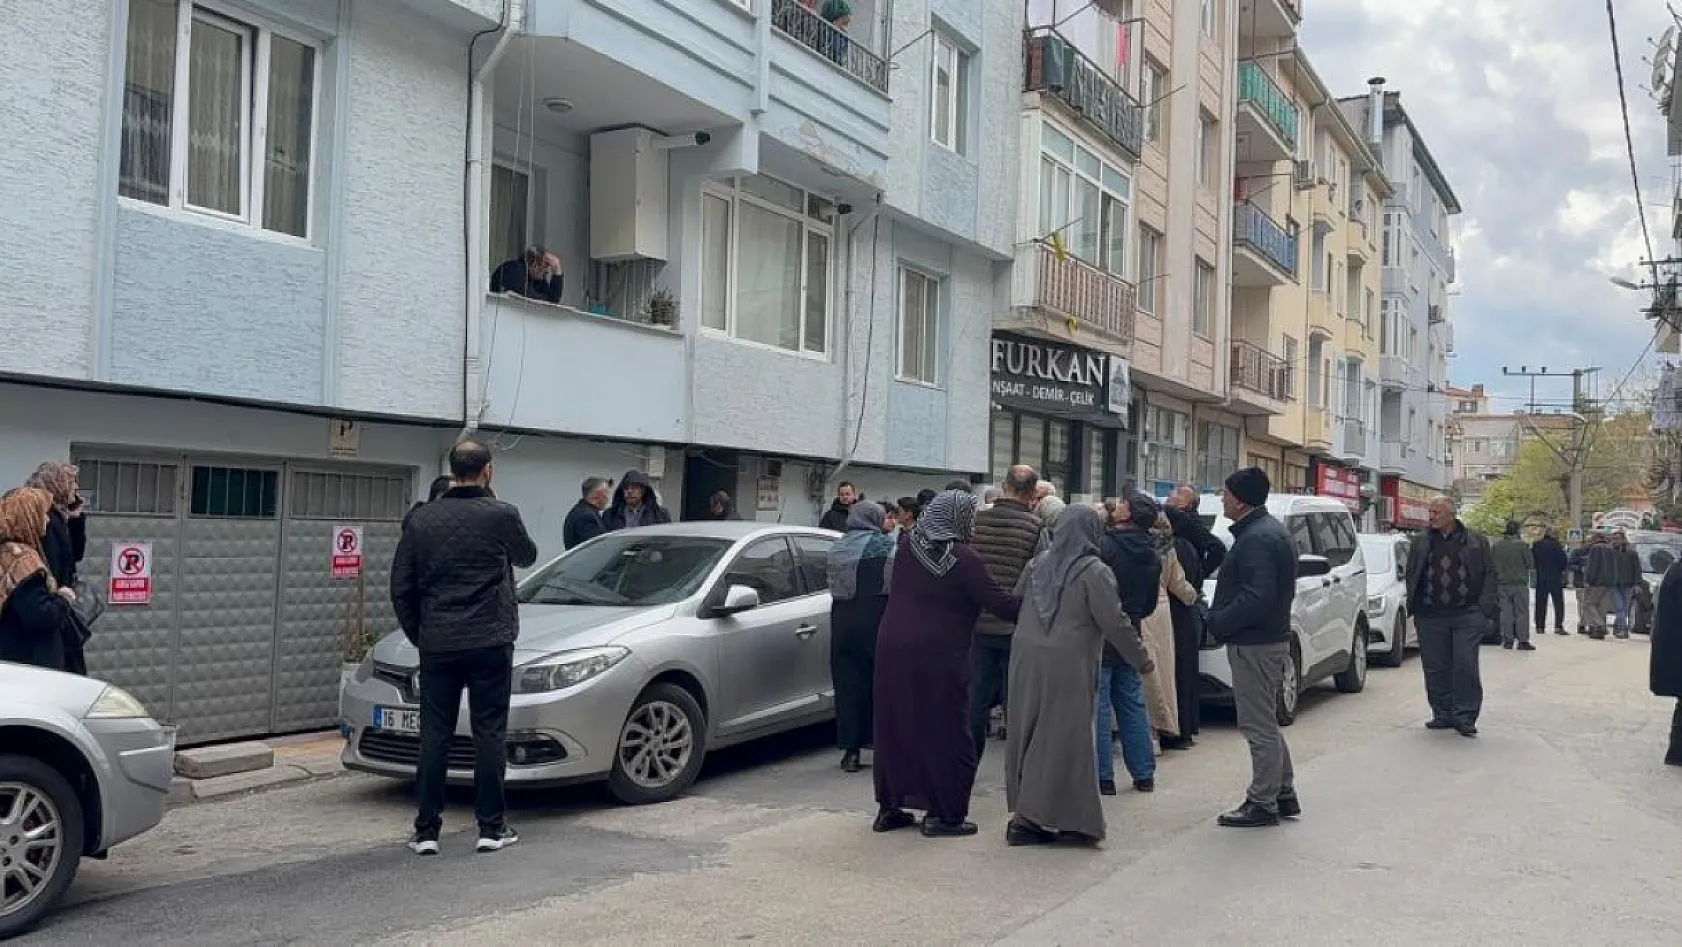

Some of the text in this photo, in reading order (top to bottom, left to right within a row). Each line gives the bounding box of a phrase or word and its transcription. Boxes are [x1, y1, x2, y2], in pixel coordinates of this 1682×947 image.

[992, 338, 1106, 387] FURKAN
[992, 380, 1026, 397] NŞAAT
[383, 710, 395, 727] 16
